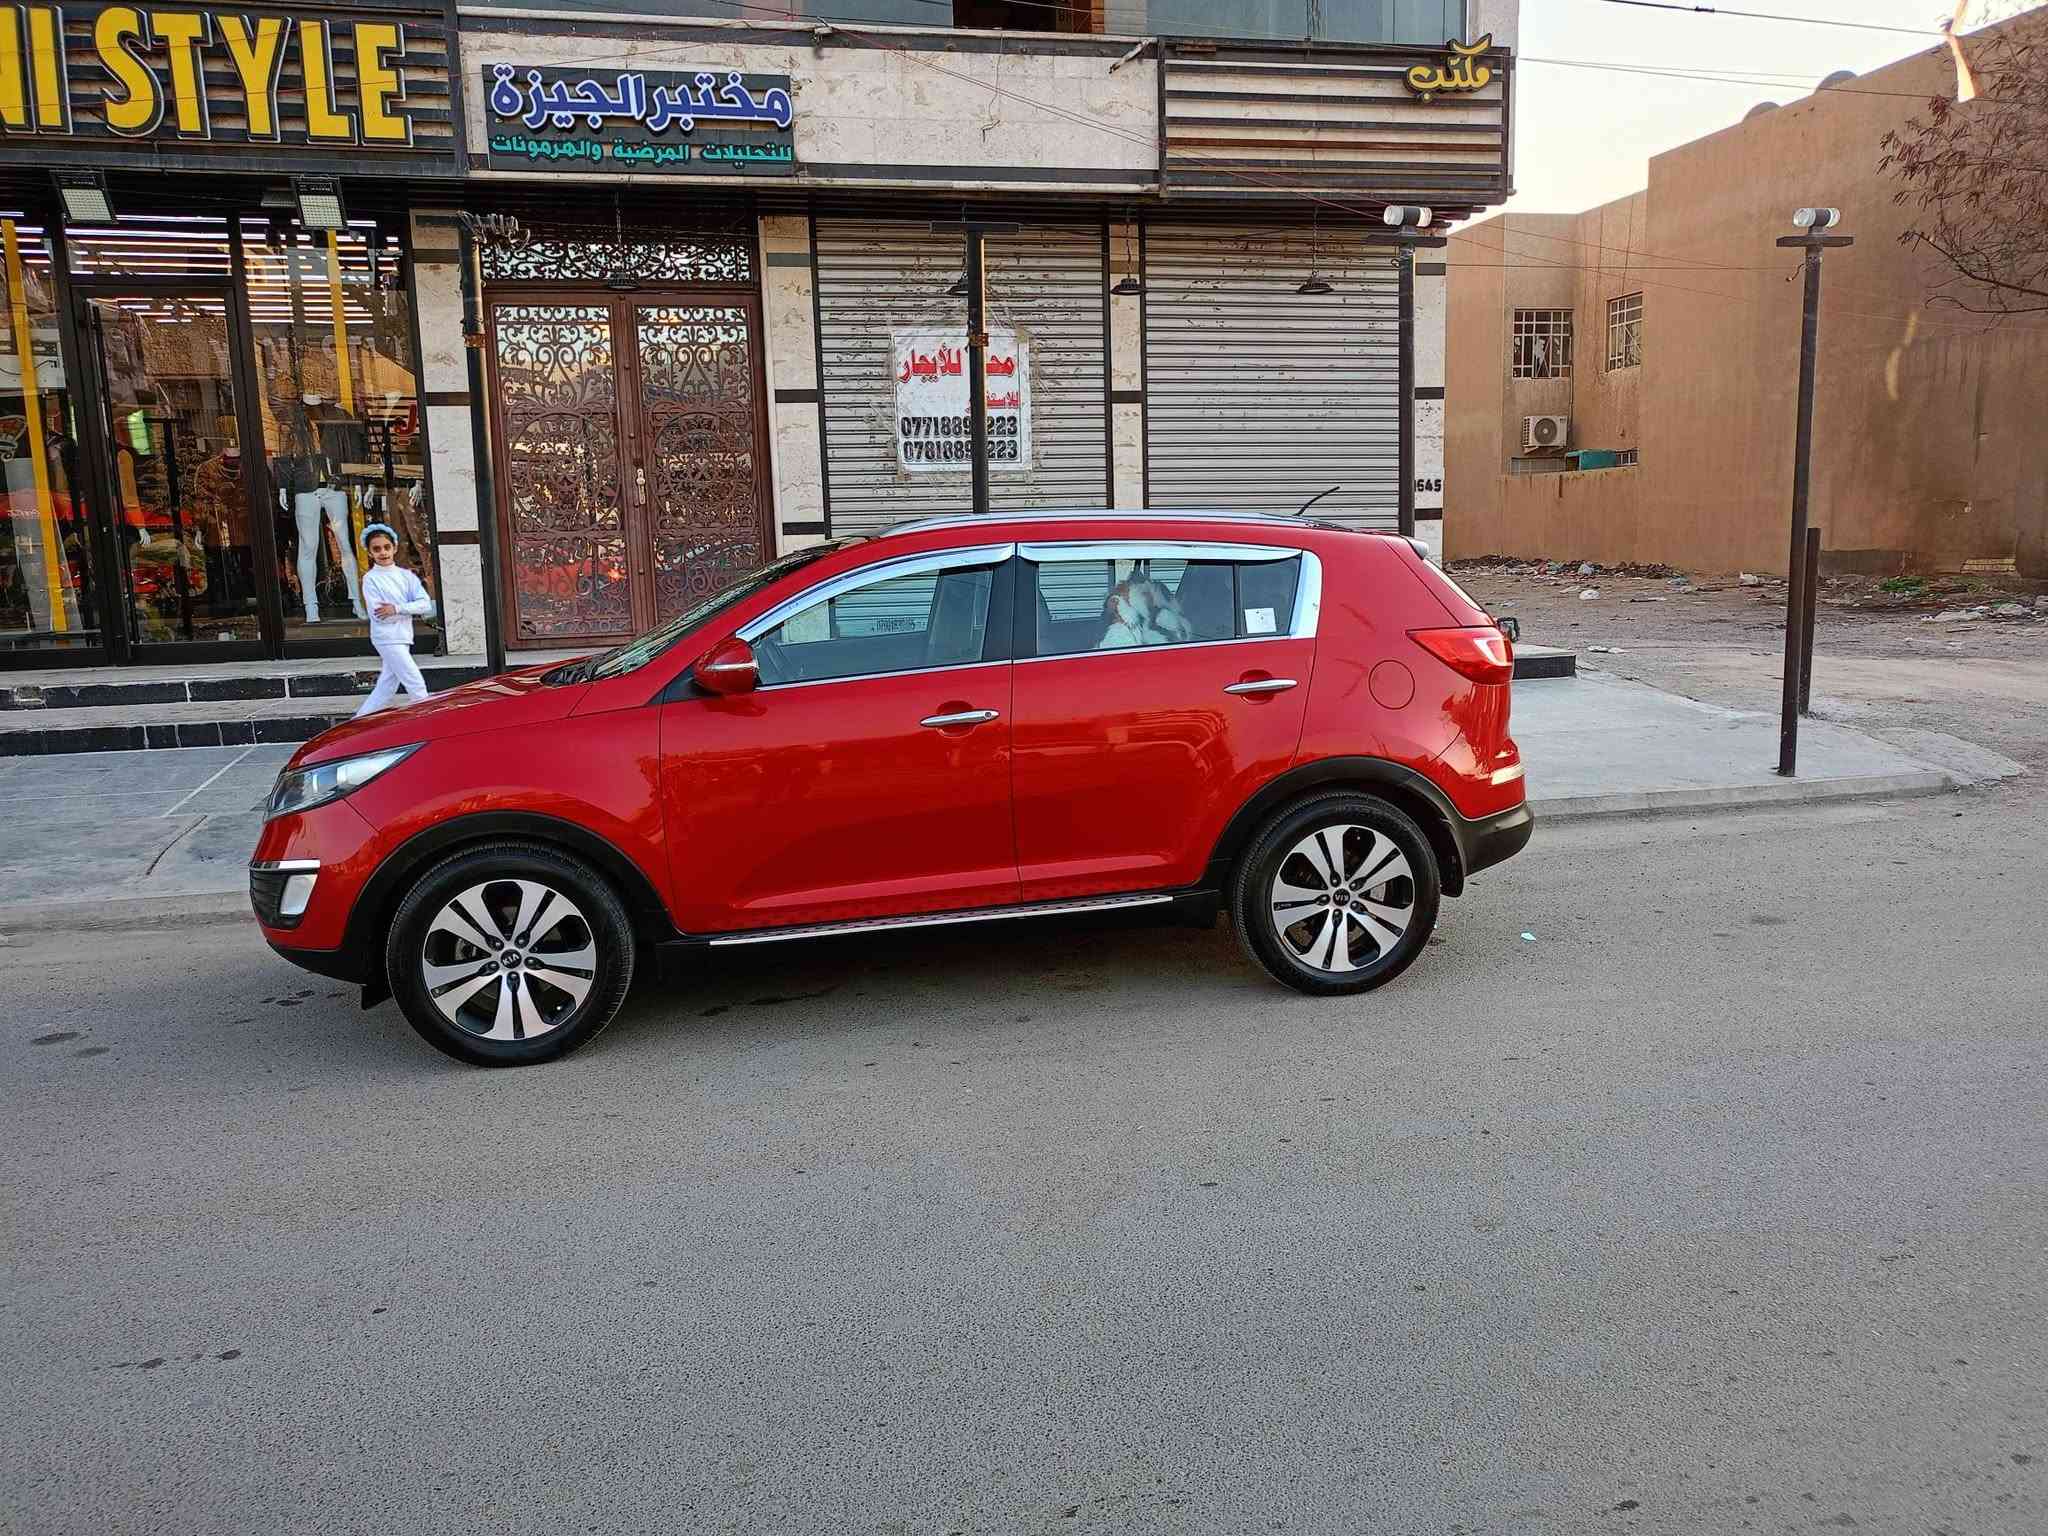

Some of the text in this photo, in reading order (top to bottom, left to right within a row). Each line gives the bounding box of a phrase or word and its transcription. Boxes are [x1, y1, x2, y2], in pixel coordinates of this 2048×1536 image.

[94, 7, 411, 145] STYLE
[491, 64, 792, 131] مختبر الجيزة
[491, 136, 793, 168] للتحليلات المرضية والهرمونات
[985, 354, 1015, 378] مح
[901, 415, 1018, 437] 0771889223
[903, 439, 1018, 461] 0781889223
[502, 953, 520, 966] KIA
